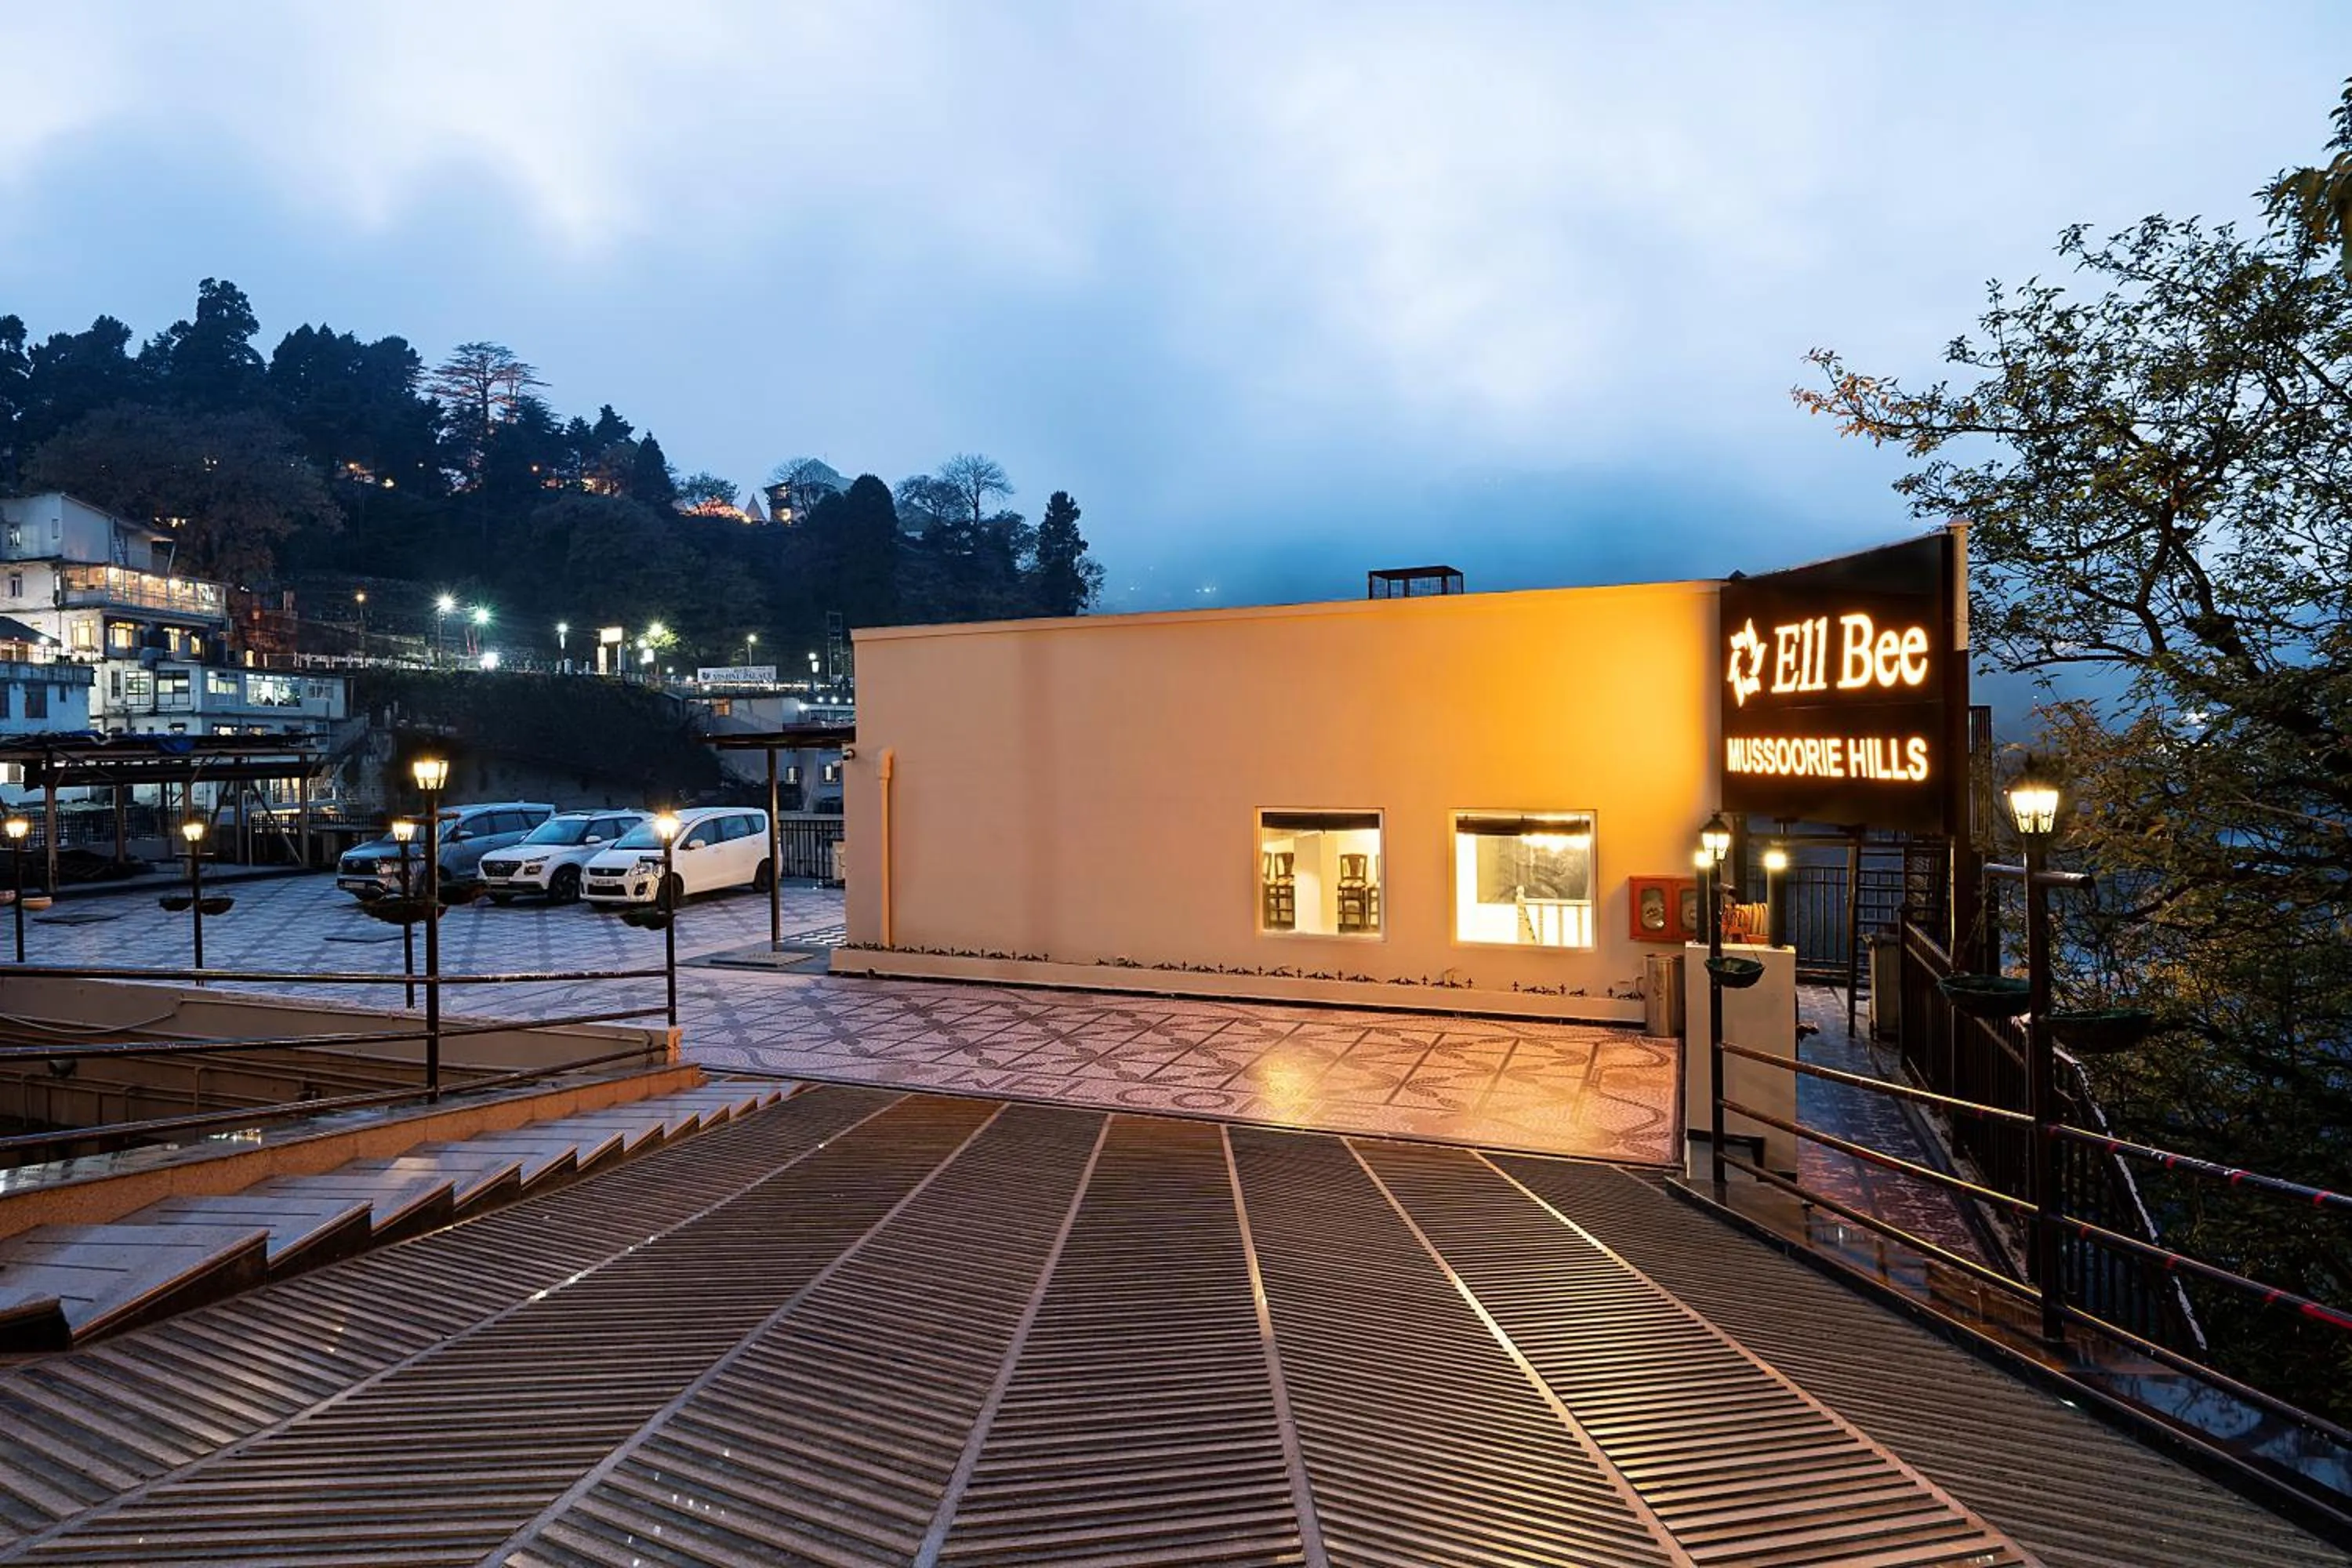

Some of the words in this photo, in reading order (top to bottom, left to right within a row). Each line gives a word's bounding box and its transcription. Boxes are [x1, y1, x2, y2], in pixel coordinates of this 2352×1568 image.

[1770, 616, 1828, 694] Ell
[1836, 613, 1929, 689] Bee
[1726, 737, 1845, 778] MUSSOORIE
[1848, 737, 1929, 782] HILLS
